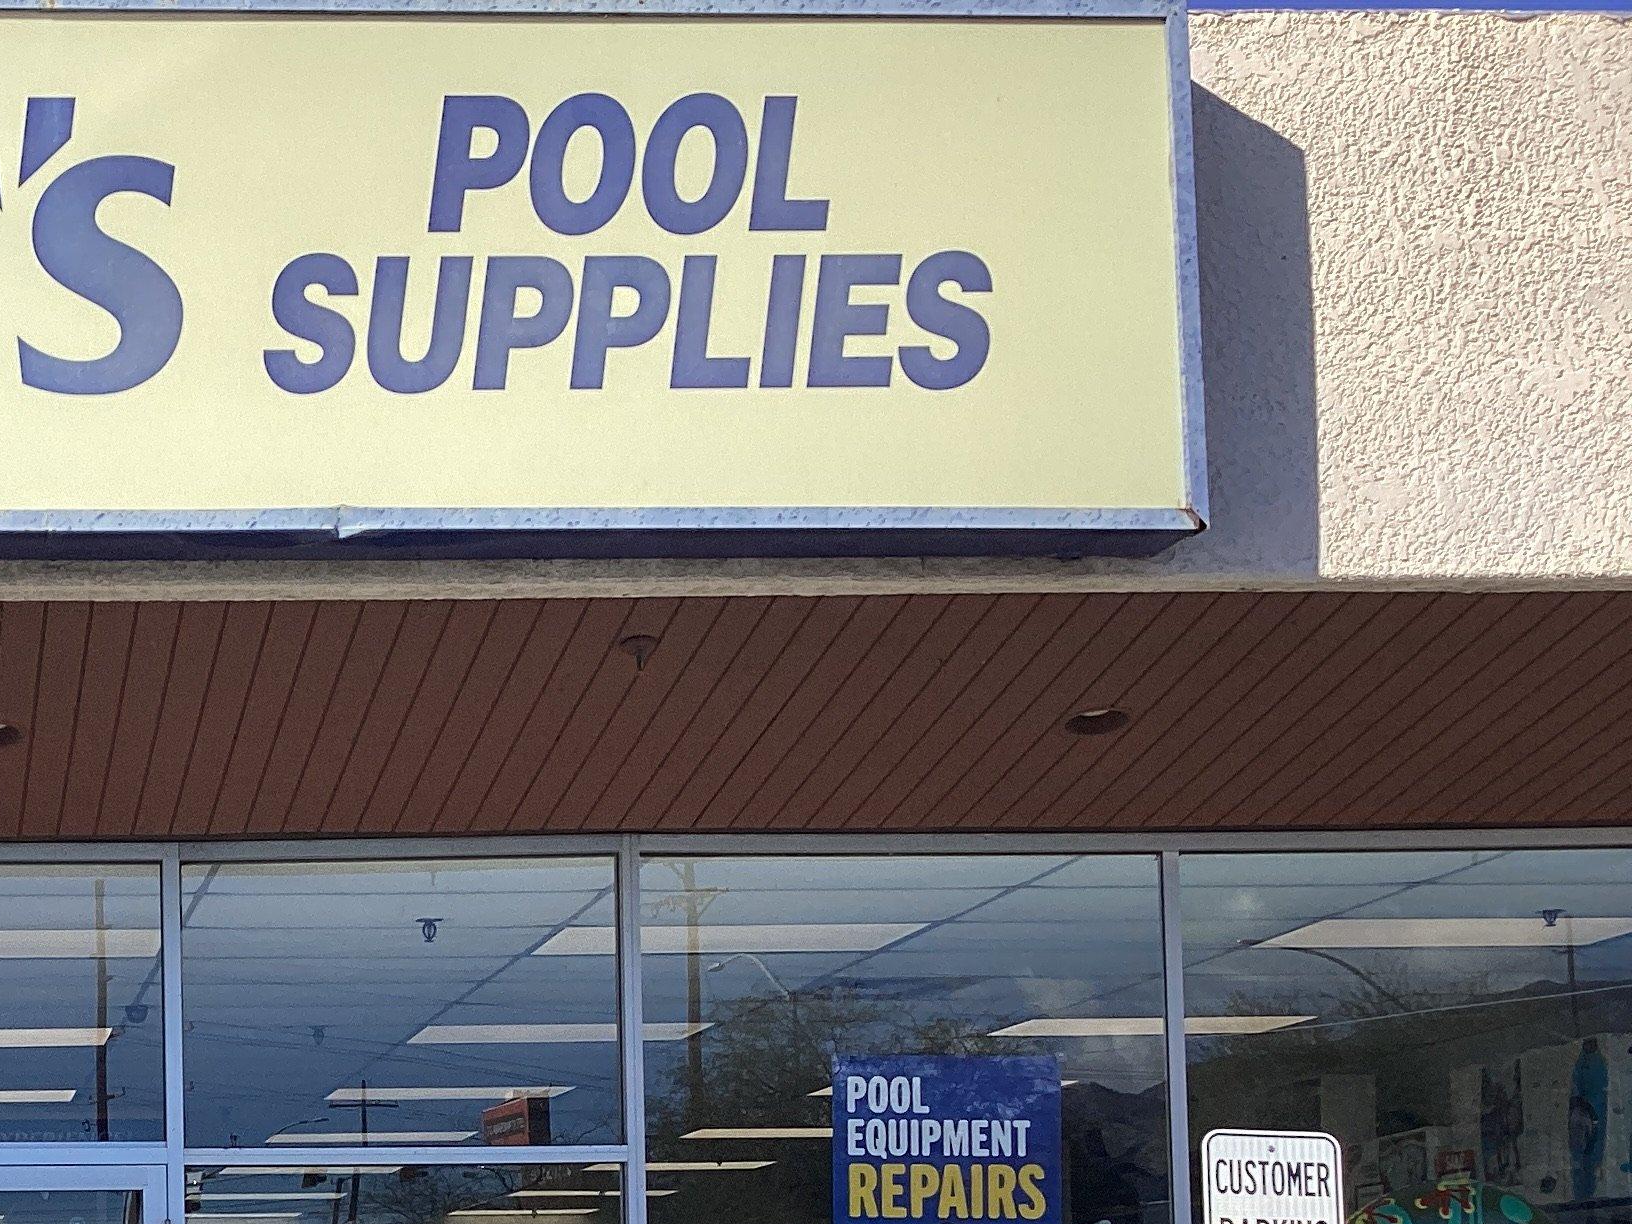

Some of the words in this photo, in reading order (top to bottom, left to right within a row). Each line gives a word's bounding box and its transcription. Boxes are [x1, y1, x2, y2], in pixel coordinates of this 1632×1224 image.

[428, 92, 830, 236] POOL
[264, 250, 993, 394] SUPPLIES
[846, 1075, 931, 1114] POOL
[847, 1118, 1031, 1159] EQUIPMENT
[848, 1163, 1047, 1220] REPAIRS
[1215, 1159, 1331, 1197] CUSTOMER
